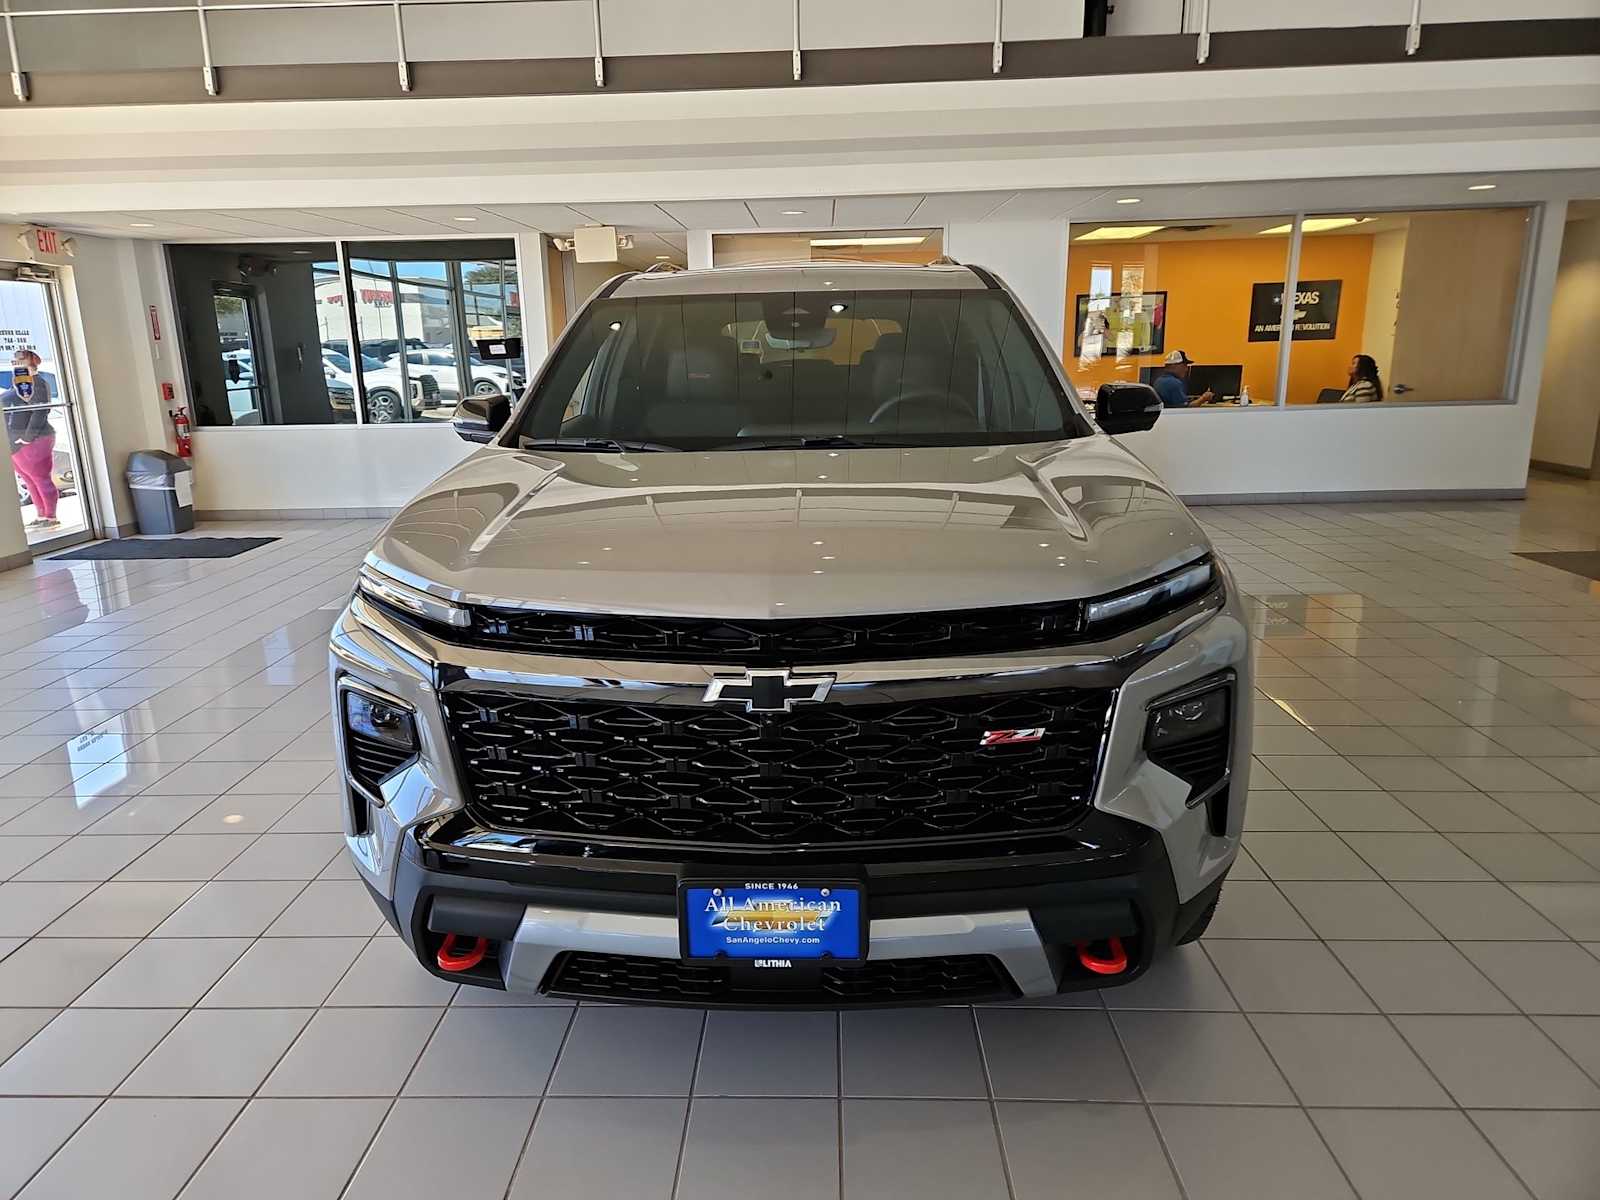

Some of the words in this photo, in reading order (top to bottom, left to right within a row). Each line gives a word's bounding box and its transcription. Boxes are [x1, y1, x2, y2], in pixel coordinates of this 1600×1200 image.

[36, 229, 58, 254] EXIT
[1281, 291, 1320, 304] EXAS
[1295, 322, 1331, 331] REVOLUTION
[744, 882, 775, 890] SINCE
[777, 882, 799, 890] 1946
[704, 896, 735, 912] All
[743, 897, 842, 912] American
[723, 915, 825, 932] Chevrolet
[726, 936, 821, 945] SanAngeloChevy.com
